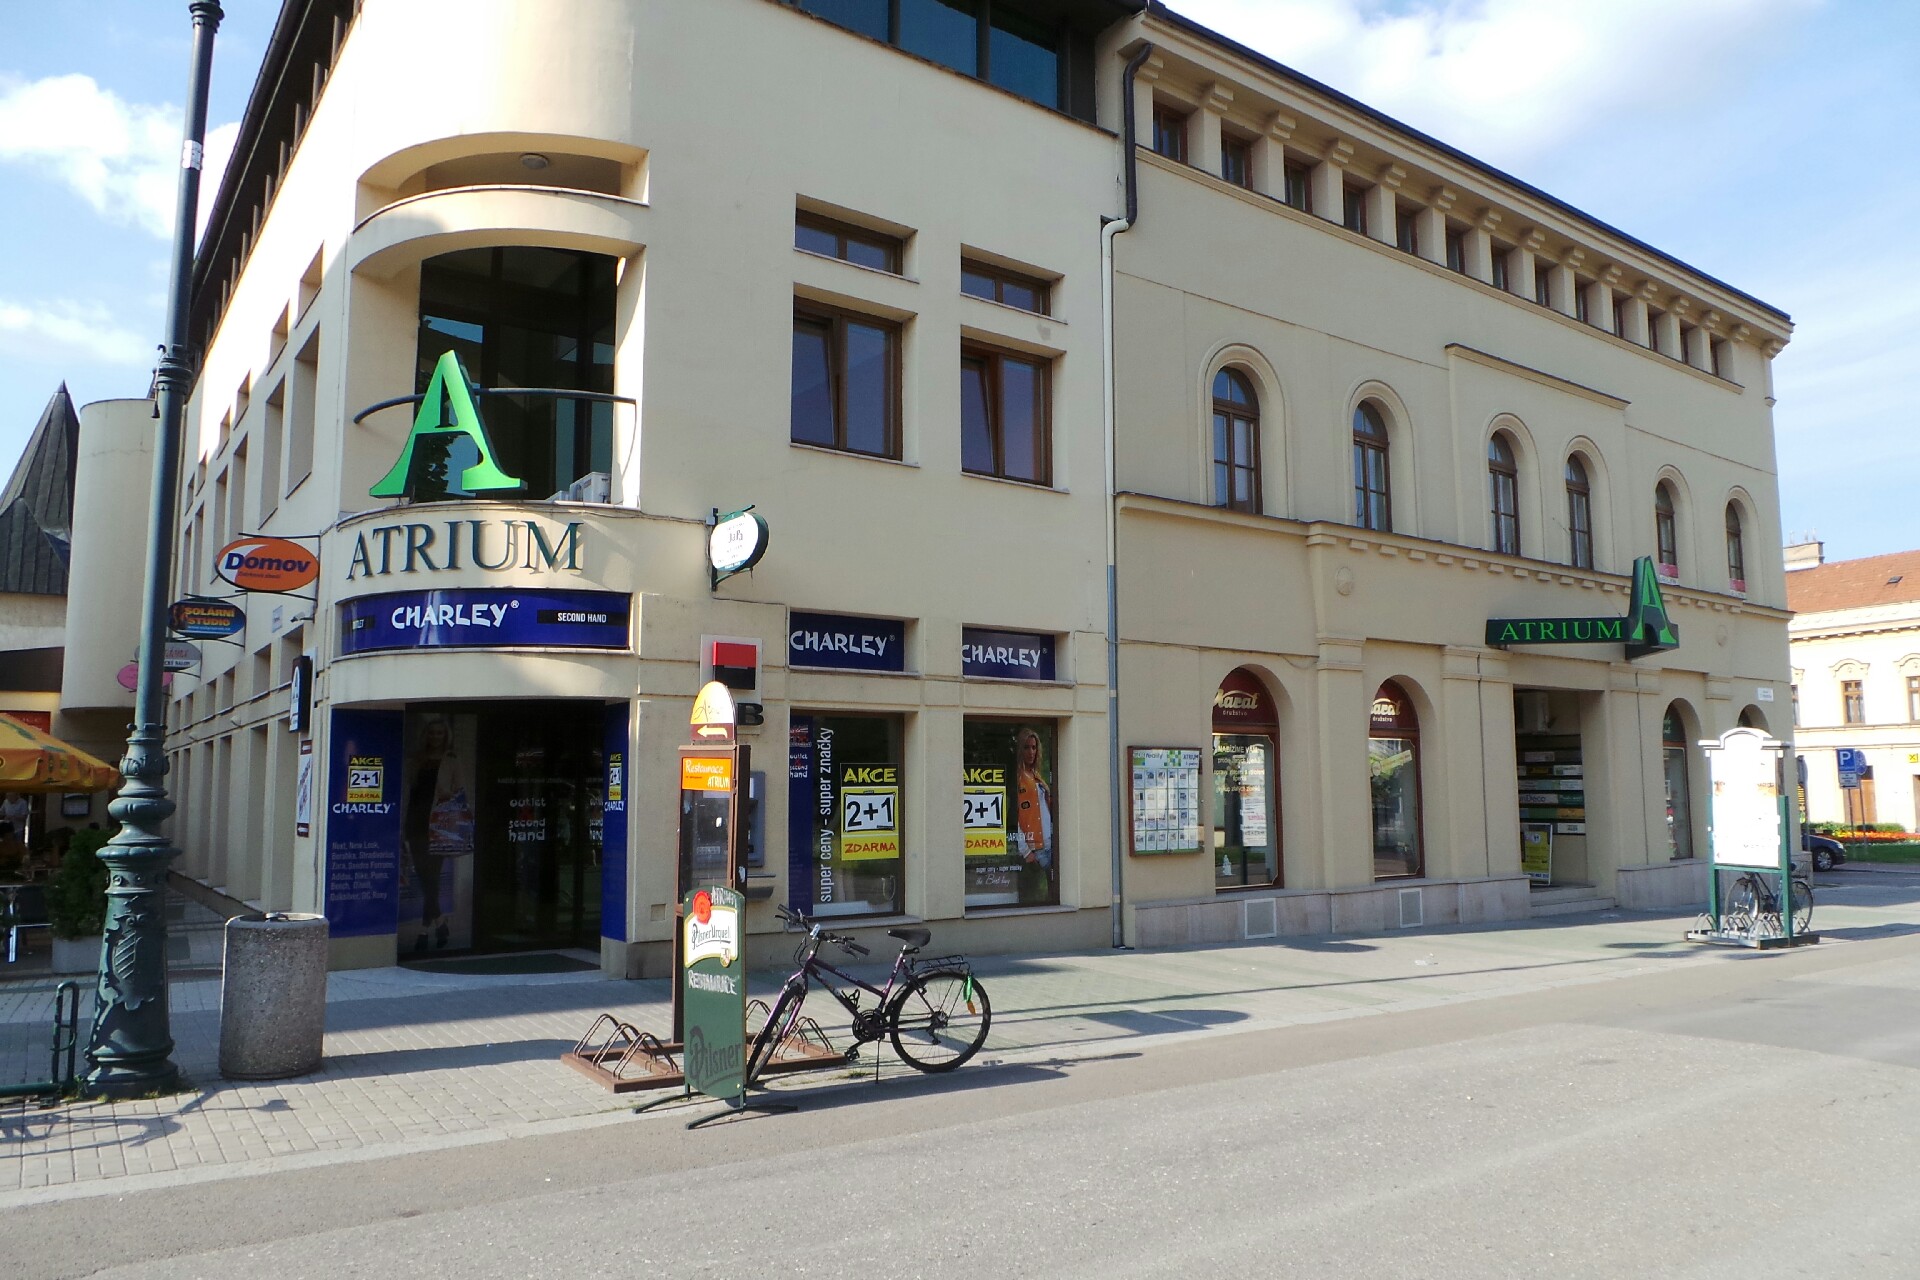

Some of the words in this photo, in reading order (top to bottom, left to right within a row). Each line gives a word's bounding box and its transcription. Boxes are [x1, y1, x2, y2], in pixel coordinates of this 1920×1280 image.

[369, 350, 521, 496] A
[346, 520, 584, 580] ATRIUM
[225, 552, 311, 573] Domov
[1631, 559, 1678, 644] A
[187, 617, 231, 626] STUDIO
[557, 612, 586, 623] SECOND
[588, 613, 607, 623] HAND
[1500, 620, 1622, 641] ATRIUM
[736, 702, 764, 726] B
[1371, 700, 1401, 716] arat
[817, 727, 834, 774] značky
[1840, 751, 1851, 766] P
[350, 757, 383, 765] AKCE
[685, 759, 724, 774] Restaurace
[351, 771, 380, 786] 2+1
[790, 770, 808, 778] hand
[843, 767, 897, 784] AKCE
[509, 798, 546, 808] outlet
[820, 780, 834, 816] super
[846, 797, 893, 827] 2+1
[964, 796, 1001, 824] 2+1
[508, 818, 546, 829] second
[508, 829, 546, 842] hand
[820, 829, 834, 860] ceny
[844, 842, 897, 854] ZDARMA
[820, 864, 834, 902] super
[689, 1025, 741, 1089] Pilsner
